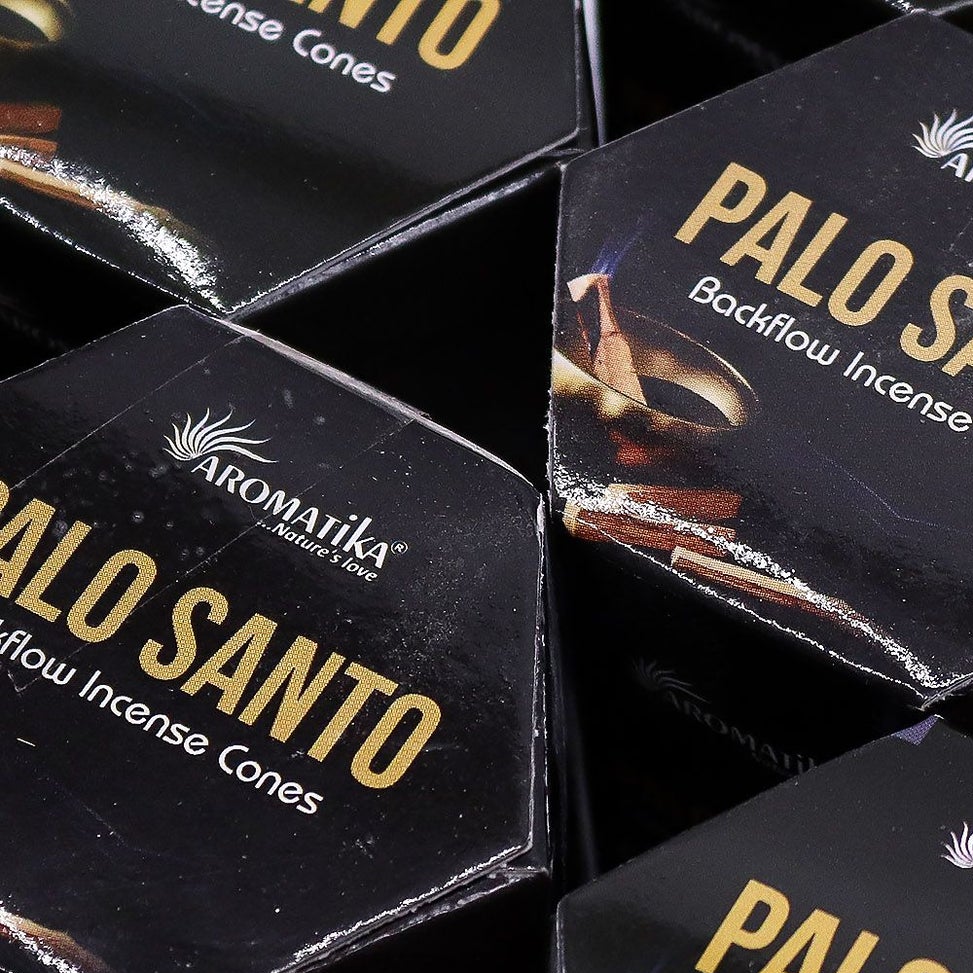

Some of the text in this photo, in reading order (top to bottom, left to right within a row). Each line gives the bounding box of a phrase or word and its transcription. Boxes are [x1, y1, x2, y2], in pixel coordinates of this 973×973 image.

[187, 0, 284, 41] ense
[293, 29, 396, 93] Cones
[674, 162, 914, 326] PALO
[688, 276, 837, 366] Backflow
[844, 351, 973, 432] Incense
[0, 480, 441, 790] ALO SANTO
[342, 558, 378, 582] love
[79, 670, 209, 755] Incense
[218, 744, 324, 816] Cones
